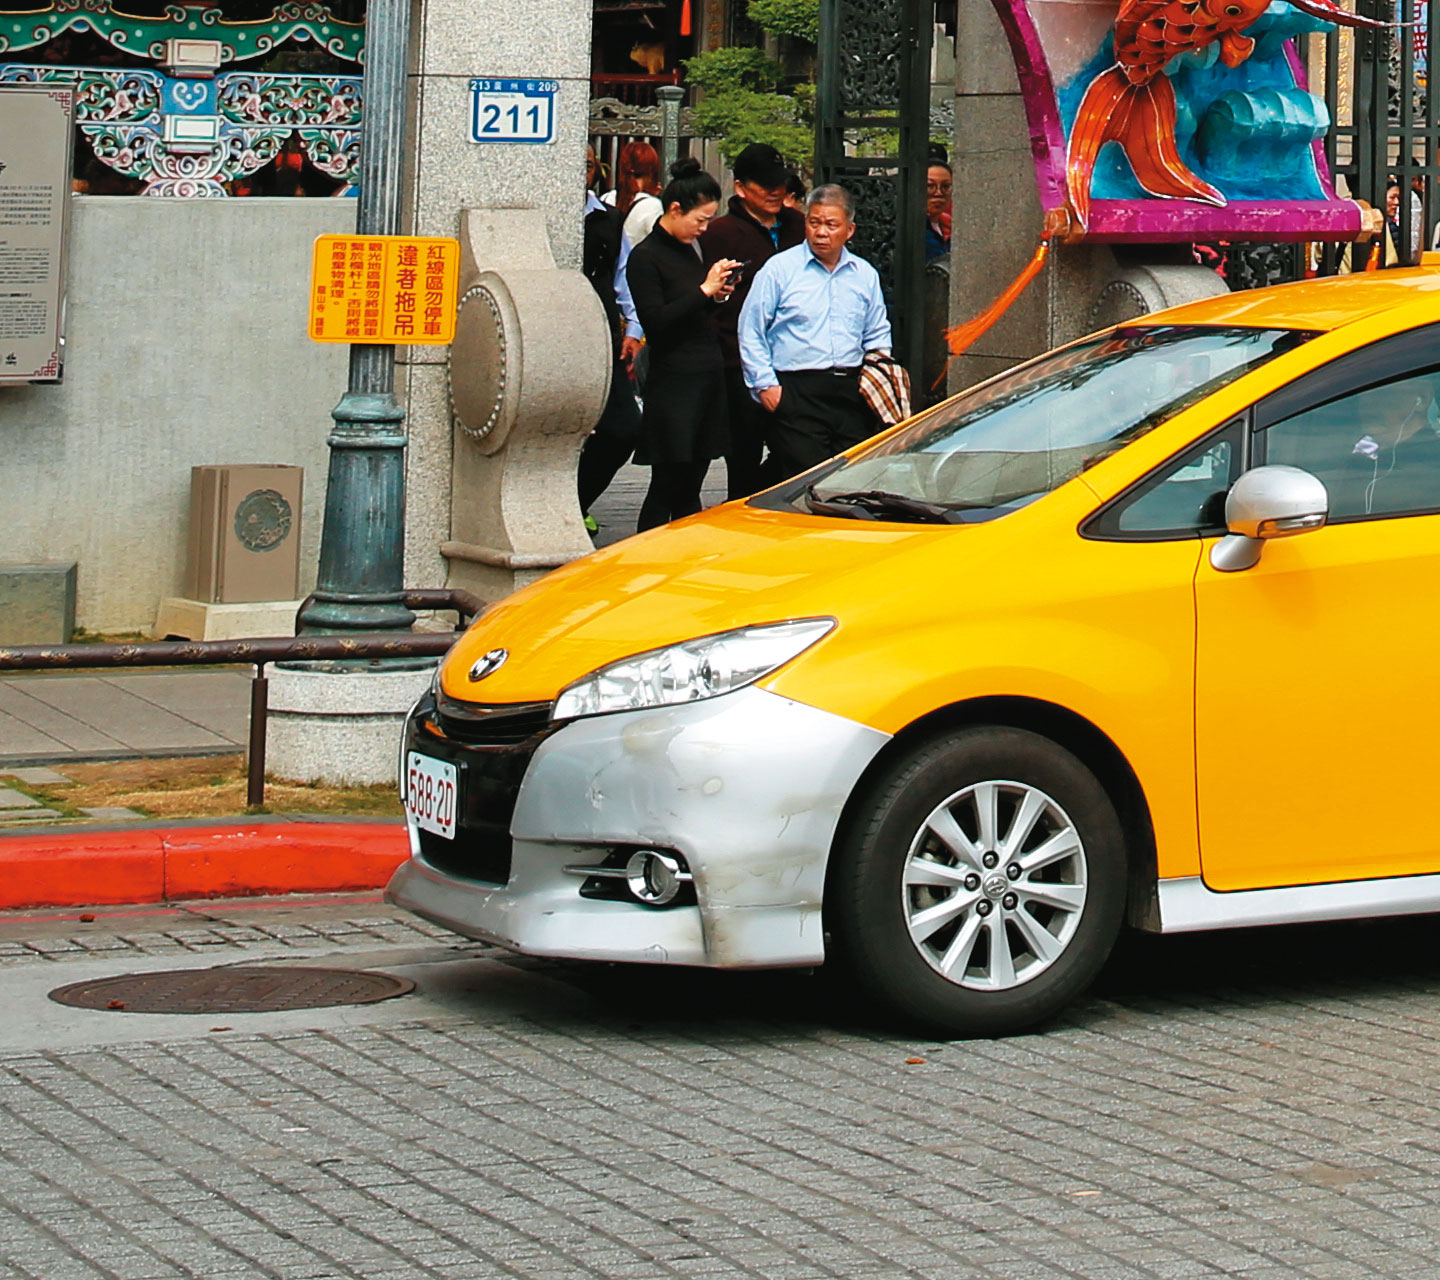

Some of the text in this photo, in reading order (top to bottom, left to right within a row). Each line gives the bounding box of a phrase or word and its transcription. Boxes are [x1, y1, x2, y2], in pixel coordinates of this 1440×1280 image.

[470, 81, 491, 91] 213
[538, 81, 558, 92] 209
[482, 104, 539, 133] 211
[394, 245, 418, 336] 違者拖吊
[423, 245, 446, 336] 紅線區勿停車
